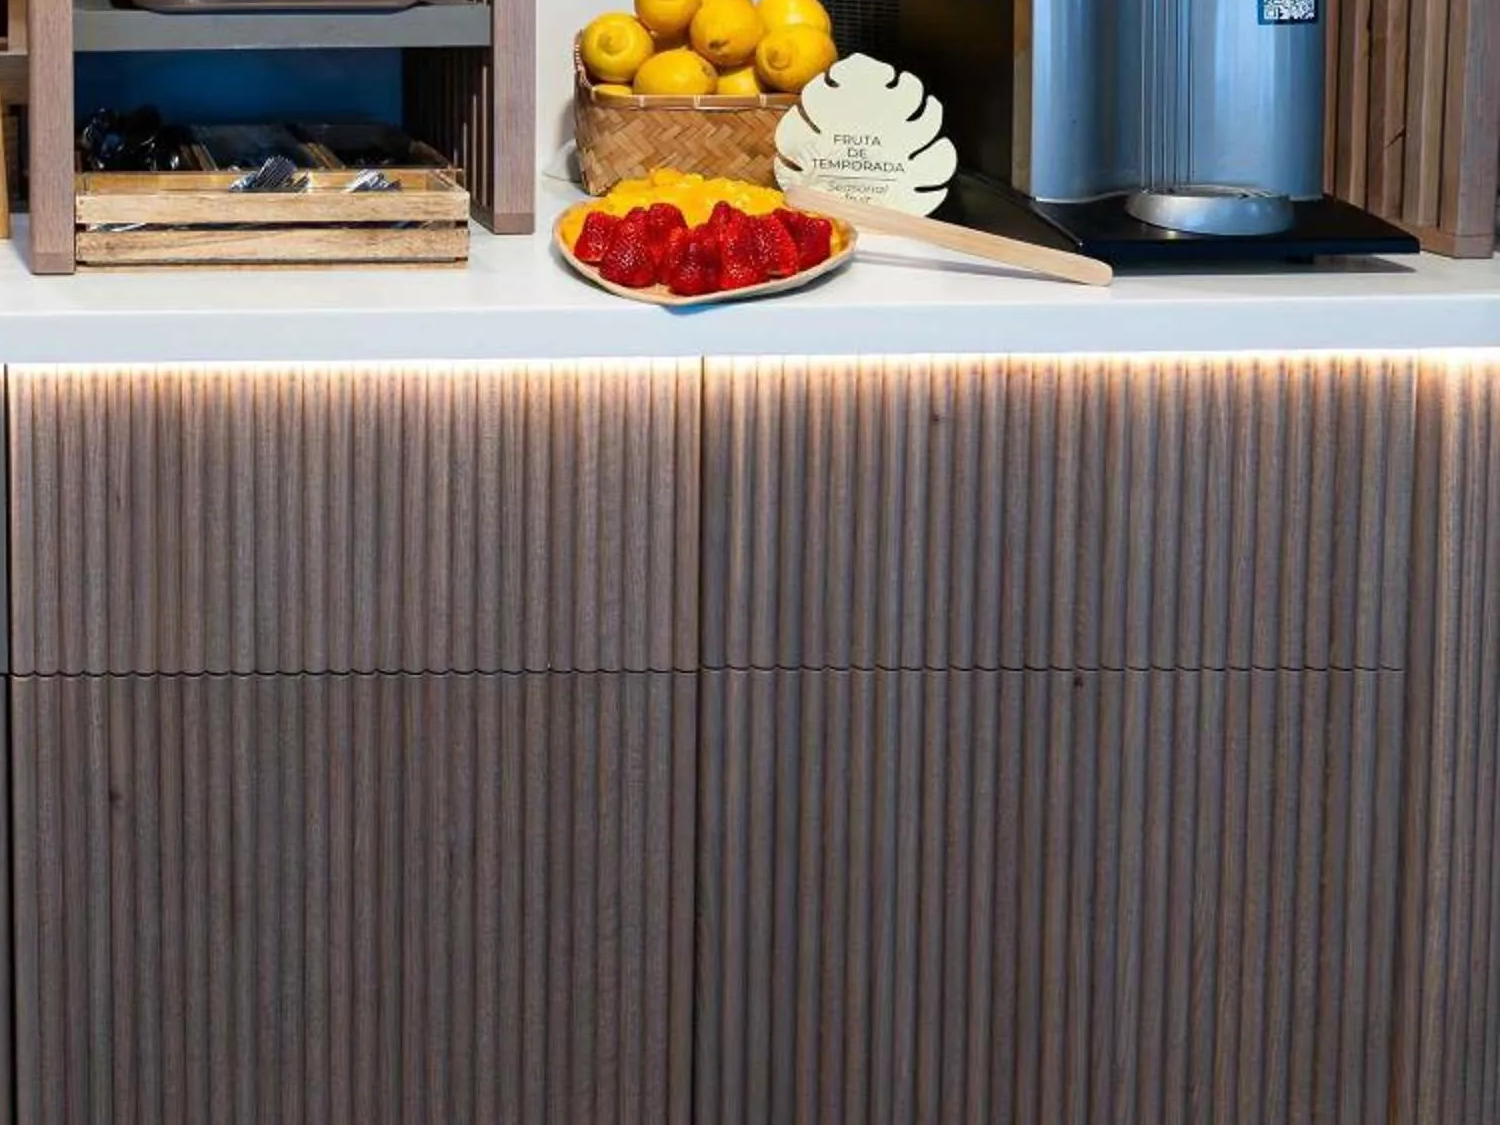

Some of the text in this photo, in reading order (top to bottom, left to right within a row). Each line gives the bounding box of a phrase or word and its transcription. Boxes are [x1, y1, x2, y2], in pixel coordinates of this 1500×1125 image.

[833, 134, 882, 147] FRUTA
[847, 147, 867, 159] DE
[812, 158, 905, 173] TEMPORADA
